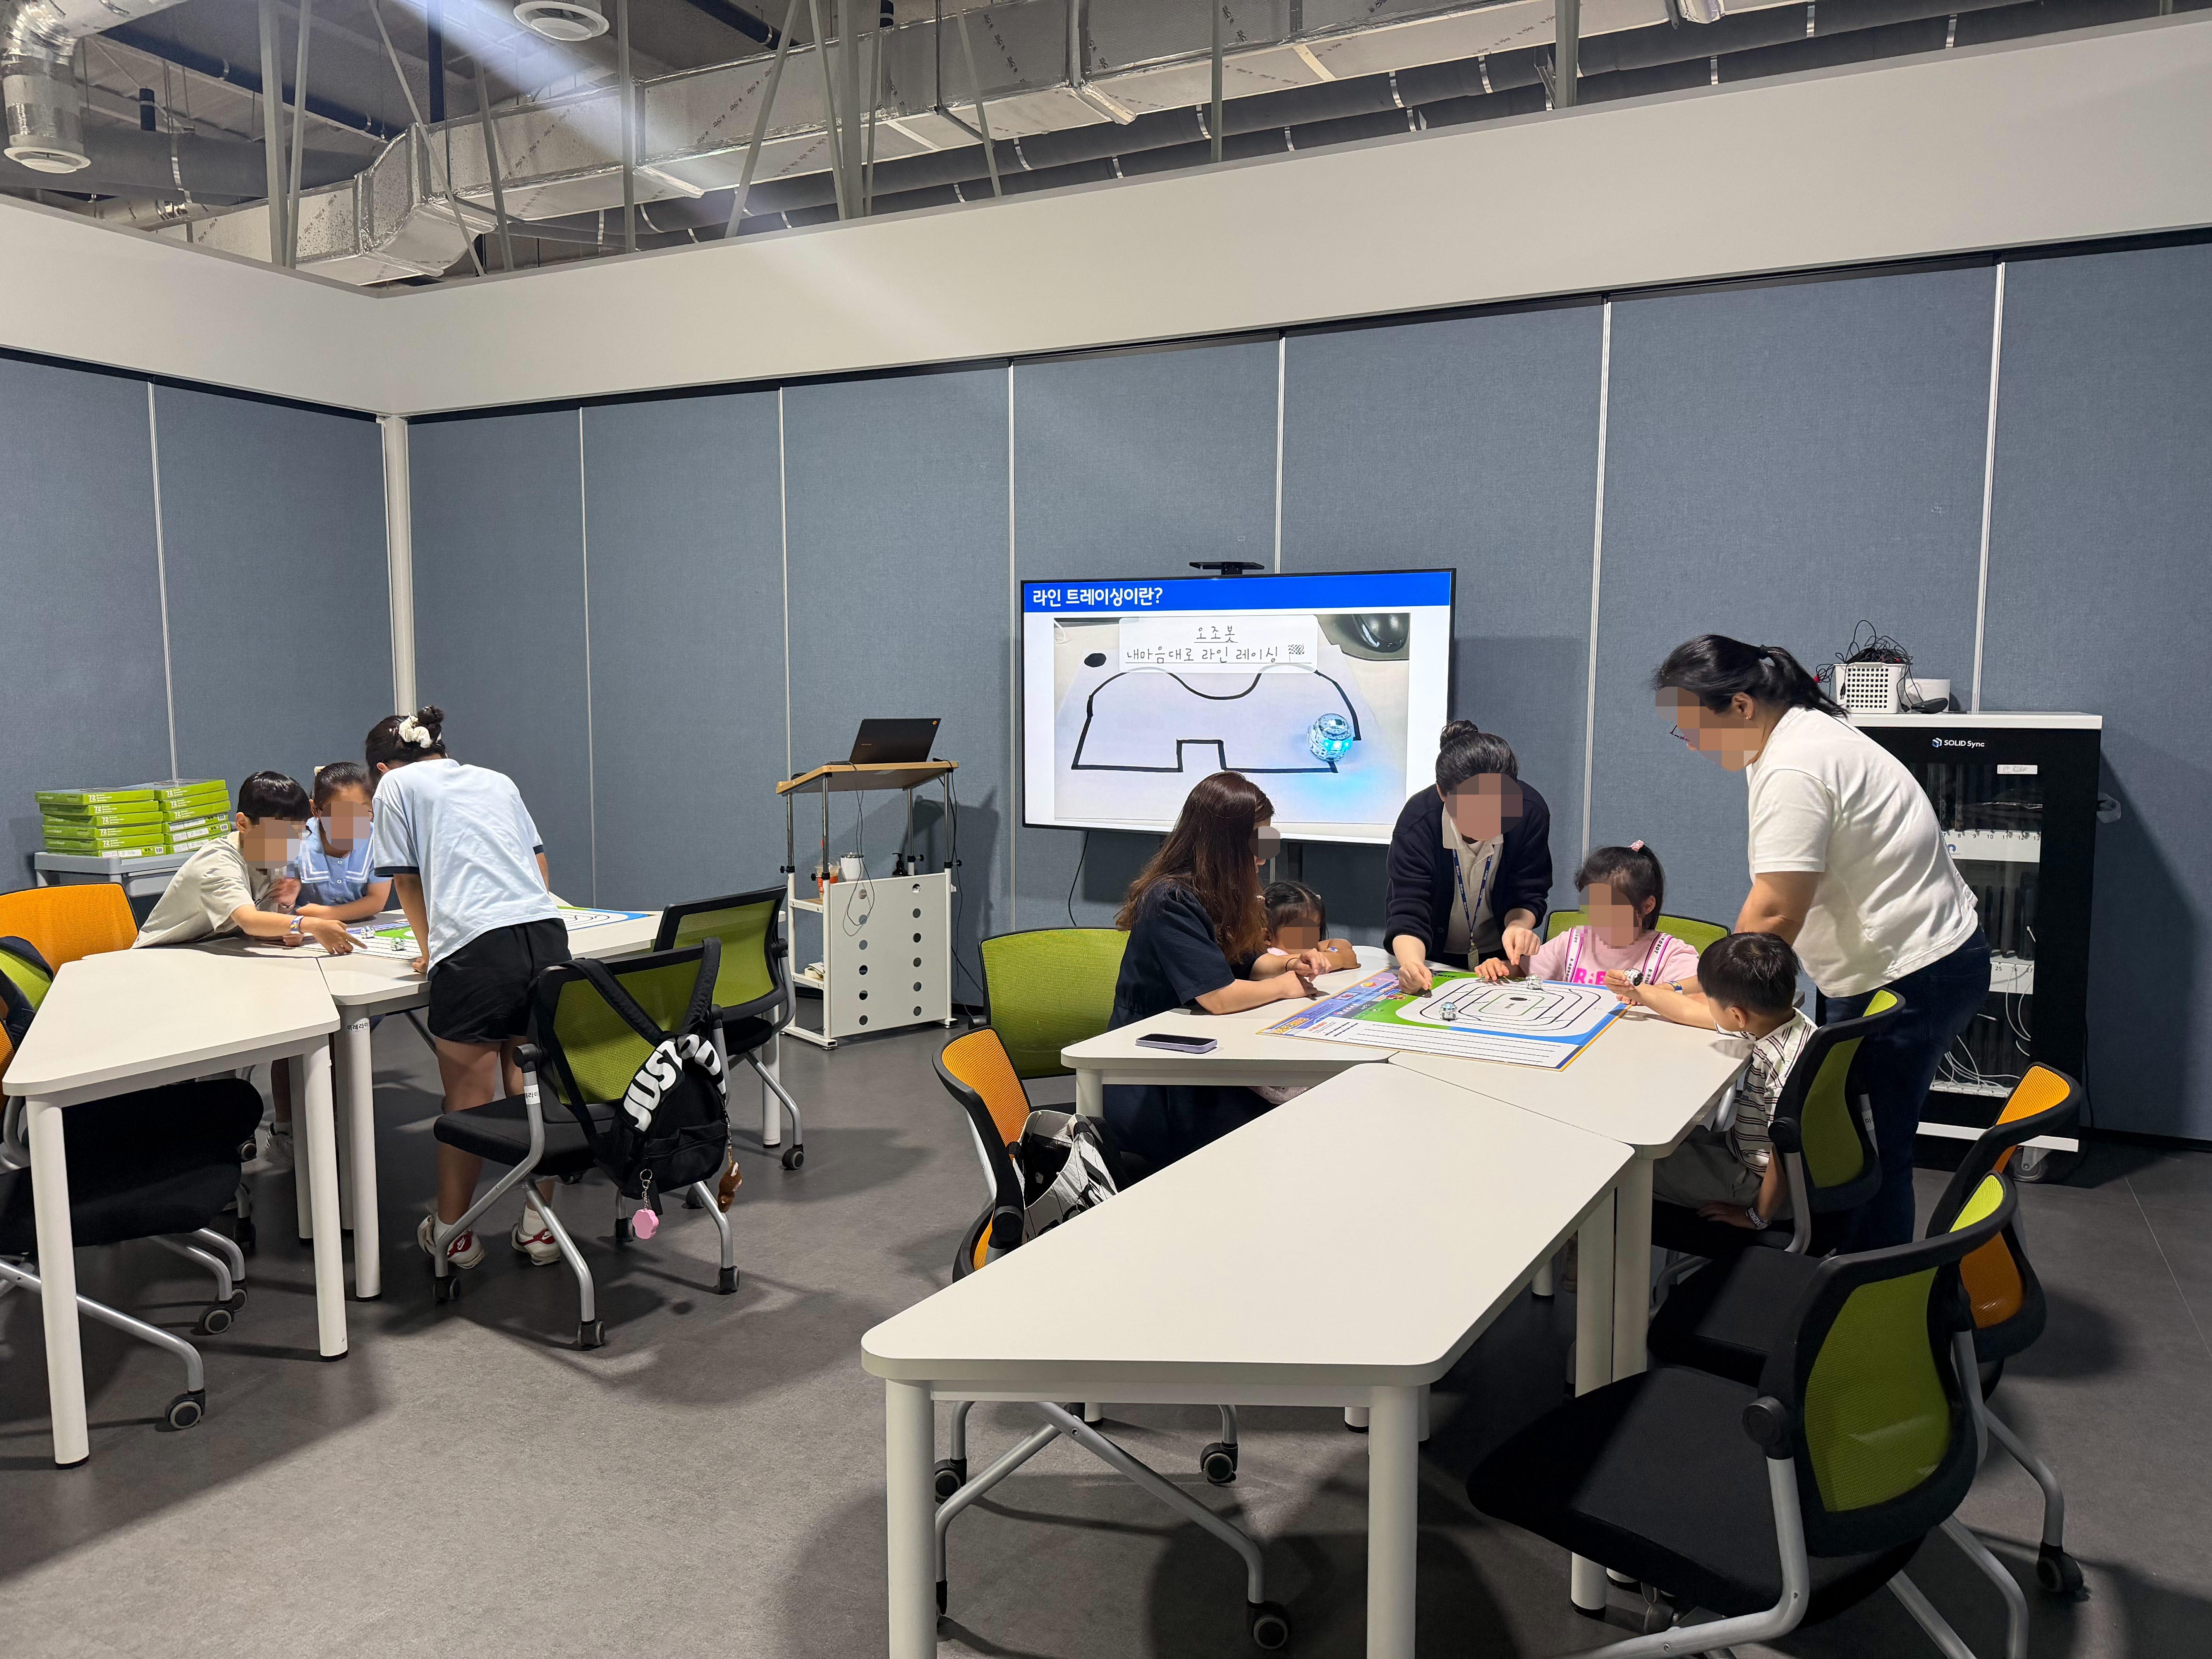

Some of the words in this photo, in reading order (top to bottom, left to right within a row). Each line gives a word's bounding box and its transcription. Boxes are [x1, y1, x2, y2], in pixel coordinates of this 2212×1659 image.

[1033, 589, 1061, 607] 라인
[1066, 587, 1163, 607] 트레이싱이란?
[1127, 646, 1194, 664] 내마음대로
[1202, 646, 1227, 663] 라인
[1236, 646, 1278, 663] 레이싱
[623, 1037, 682, 1132] JUST
